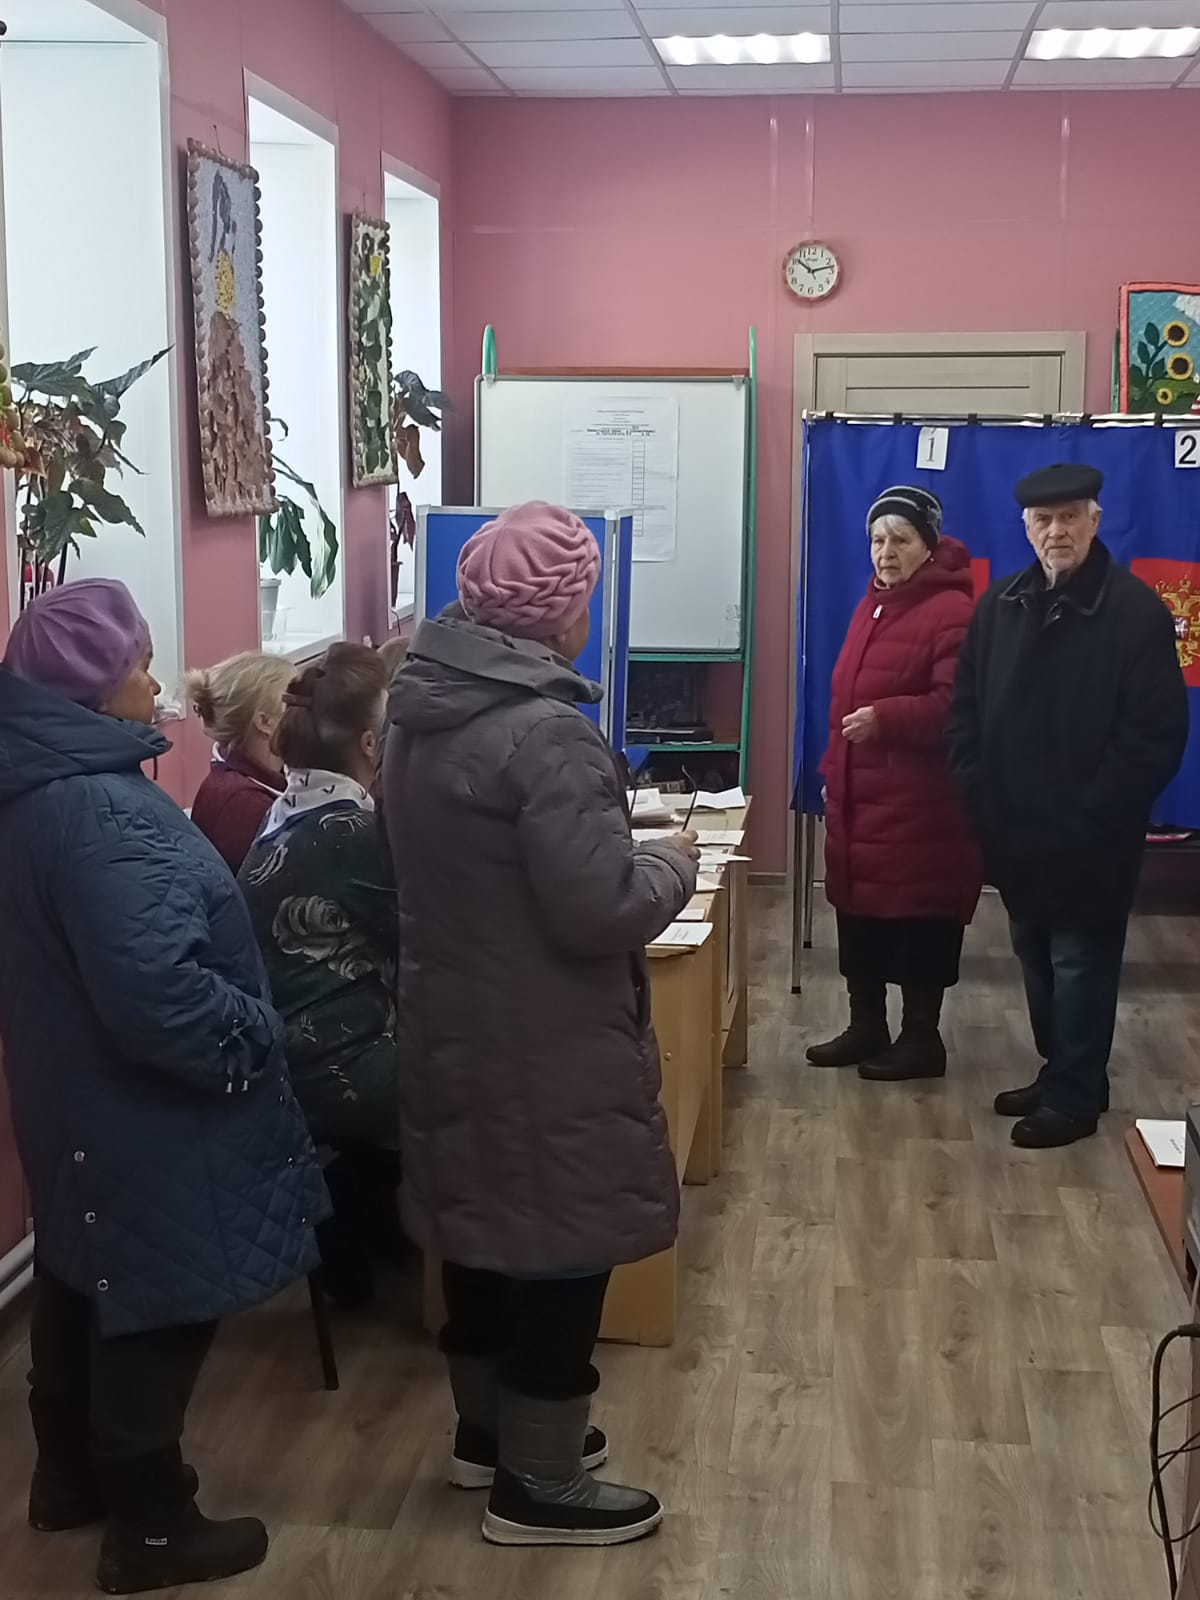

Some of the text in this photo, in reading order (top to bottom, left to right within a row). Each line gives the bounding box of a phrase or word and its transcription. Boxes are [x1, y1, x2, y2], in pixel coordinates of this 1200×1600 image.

[799, 249, 806, 258] 11
[808, 247, 816, 255] 12
[825, 257, 831, 265] 2
[791, 277, 797, 285] 8
[926, 437, 935, 462] 1
[1179, 435, 1197, 464] 2
